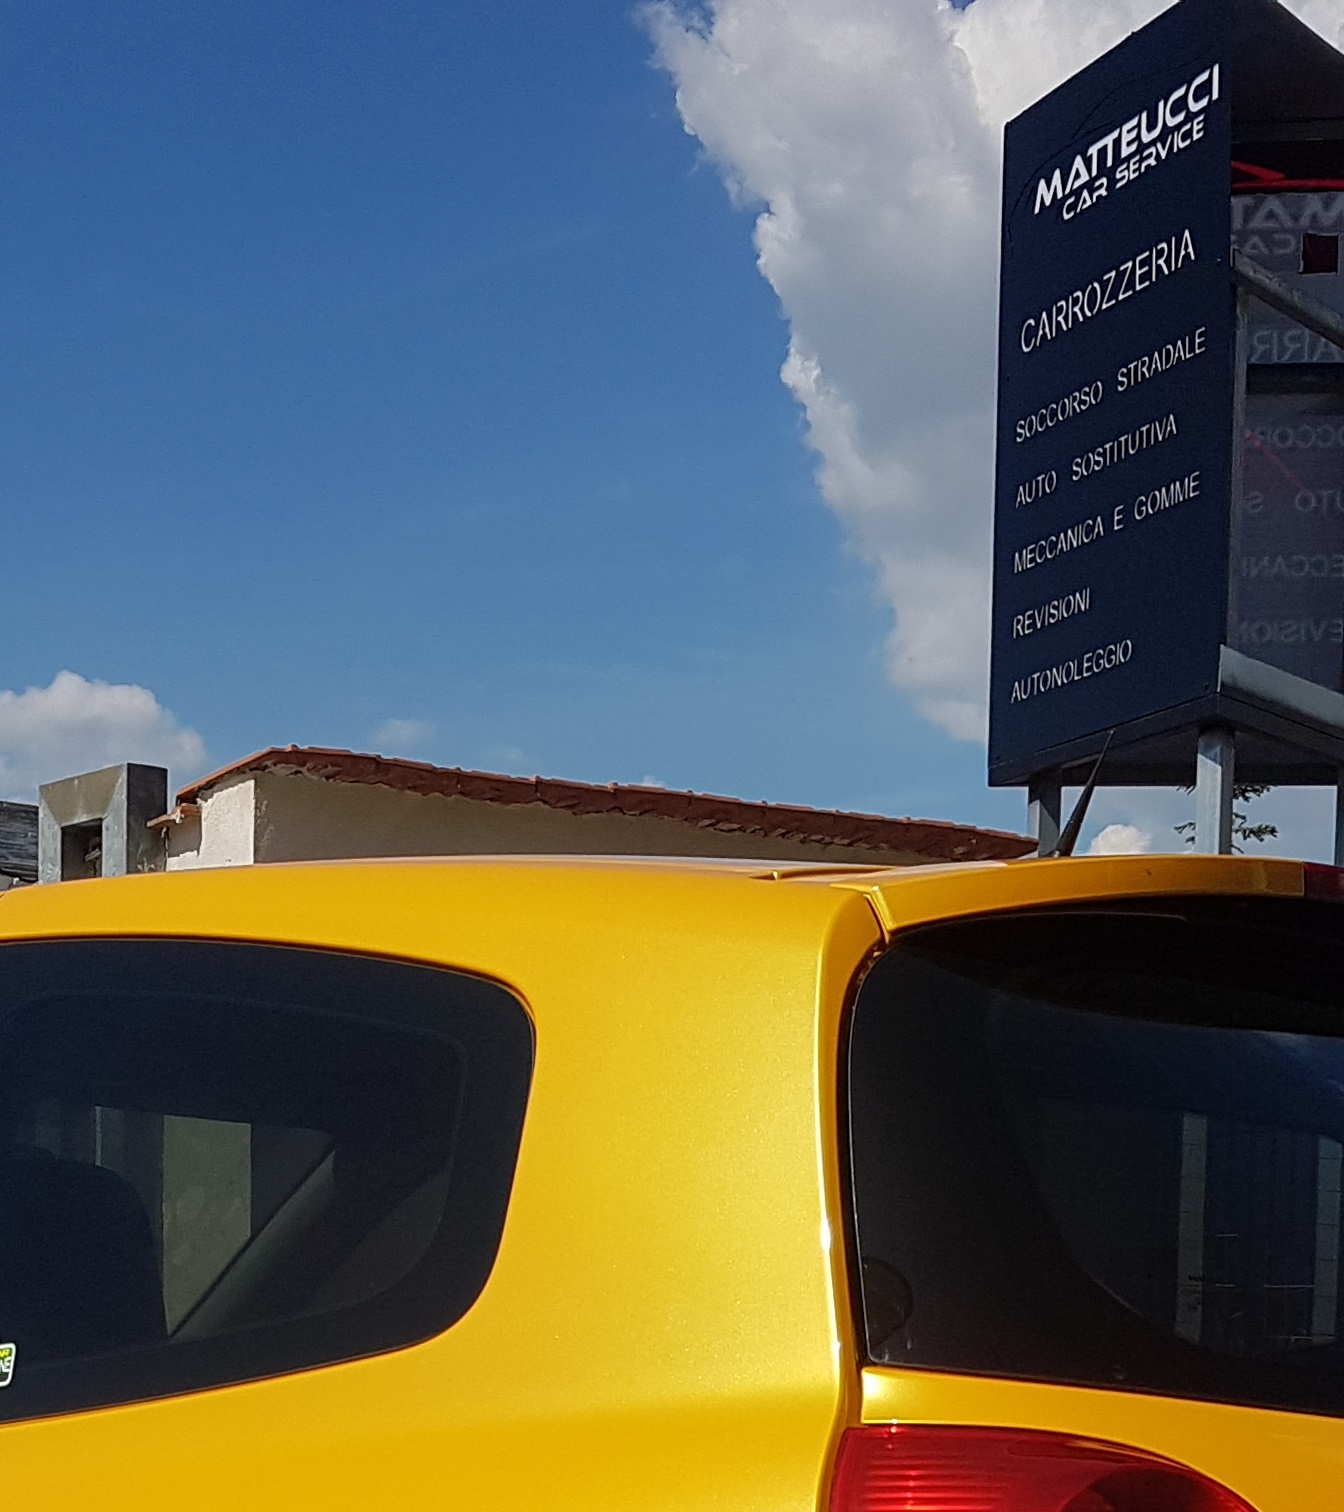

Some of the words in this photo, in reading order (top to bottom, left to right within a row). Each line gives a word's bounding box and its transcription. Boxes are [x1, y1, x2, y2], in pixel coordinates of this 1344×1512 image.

[1033, 63, 1220, 215] MATTEUCCI
[1061, 182, 1109, 222] CAR
[1115, 114, 1206, 191] SERVICE
[1020, 228, 1196, 354] CARROZZERIA
[1015, 381, 1103, 443] SOCCORSO
[1116, 326, 1207, 393] STRADALE
[1015, 469, 1057, 509] AUTO
[1071, 412, 1178, 483] SOSTITUTIVA
[1013, 519, 1104, 575] MECCANICA
[1113, 503, 1124, 532] E
[1134, 471, 1201, 522] GOMME
[1012, 587, 1091, 640] REVISIONI
[1010, 639, 1132, 704] AUTONOLEGGIO
